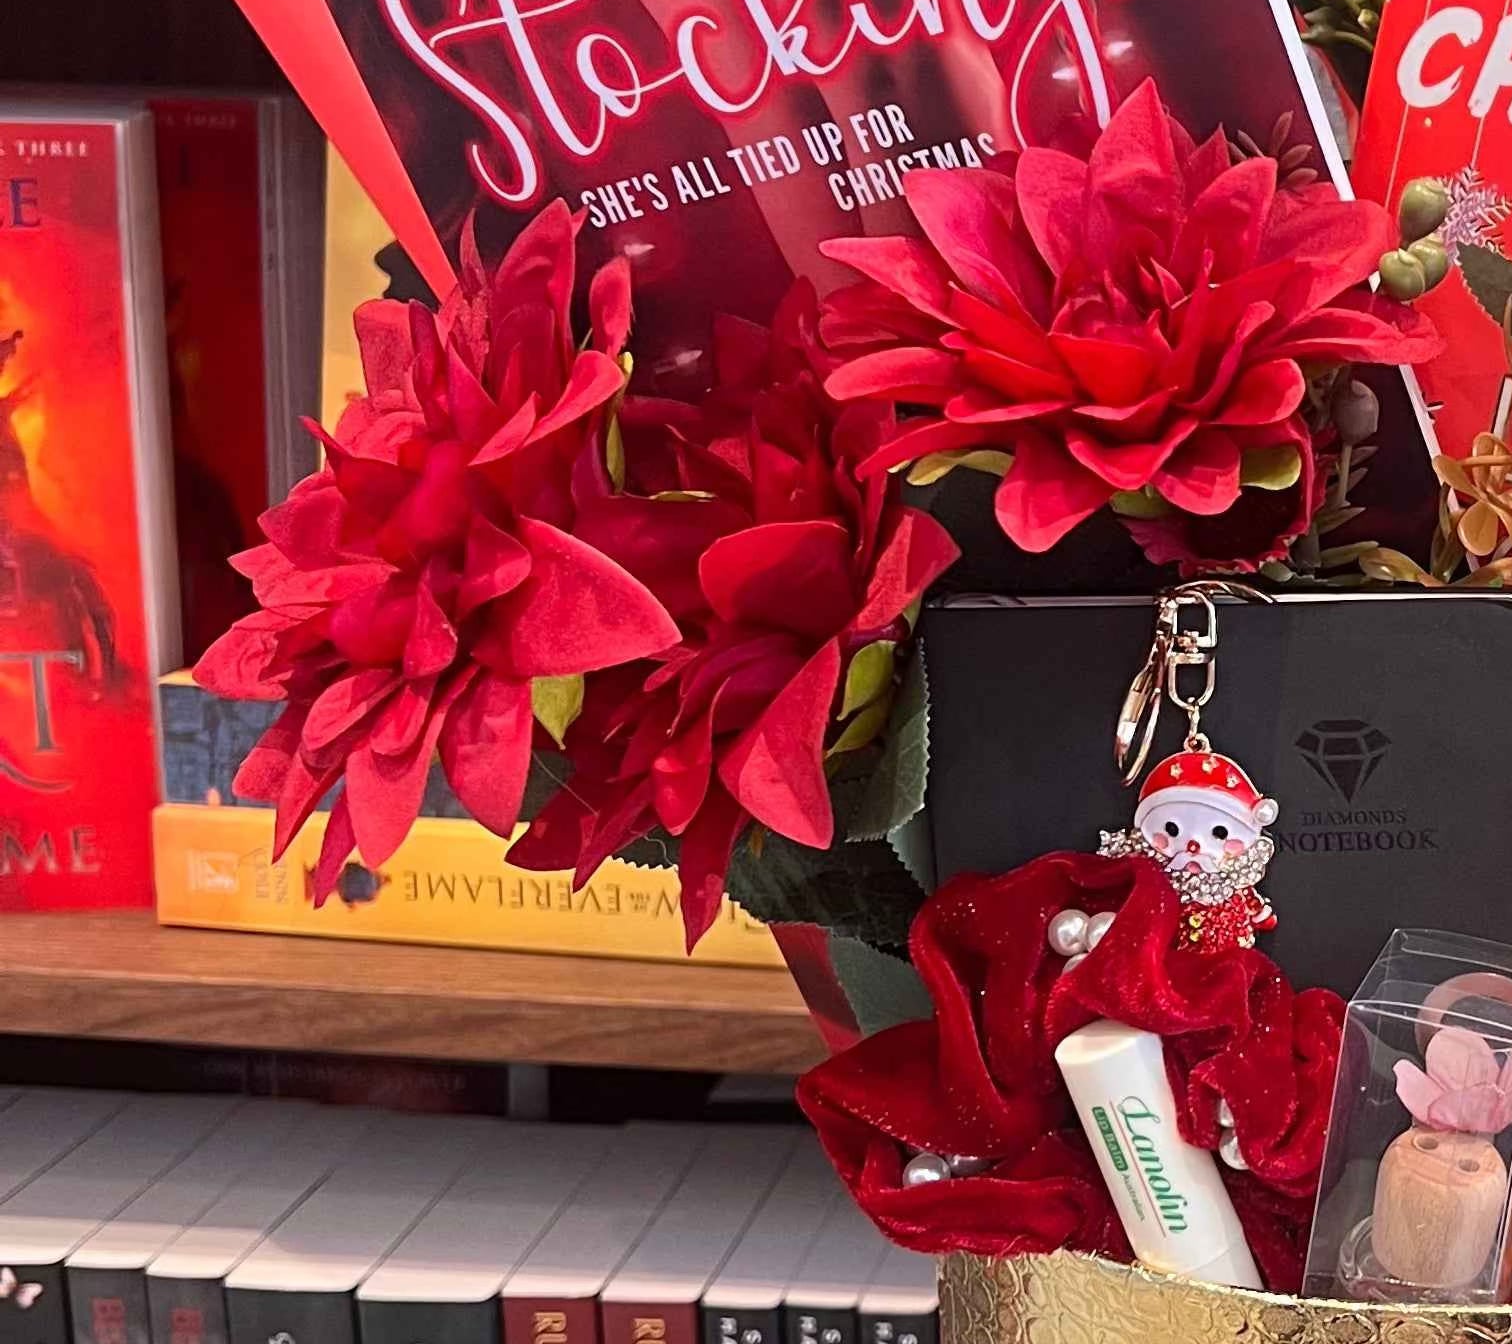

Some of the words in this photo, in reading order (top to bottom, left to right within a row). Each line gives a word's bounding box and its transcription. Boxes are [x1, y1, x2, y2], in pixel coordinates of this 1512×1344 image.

[581, 176, 670, 230] SHE'S
[672, 156, 731, 207] ALL
[727, 135, 802, 191] TIED
[803, 118, 845, 170] UP
[852, 103, 915, 153] FOR
[1301, 809, 1408, 827] DIAMONDS
[1278, 828, 1440, 854] NOTEBOOK
[403, 869, 623, 914] EVERFLAME
[1116, 1095, 1188, 1233] Lanolin
